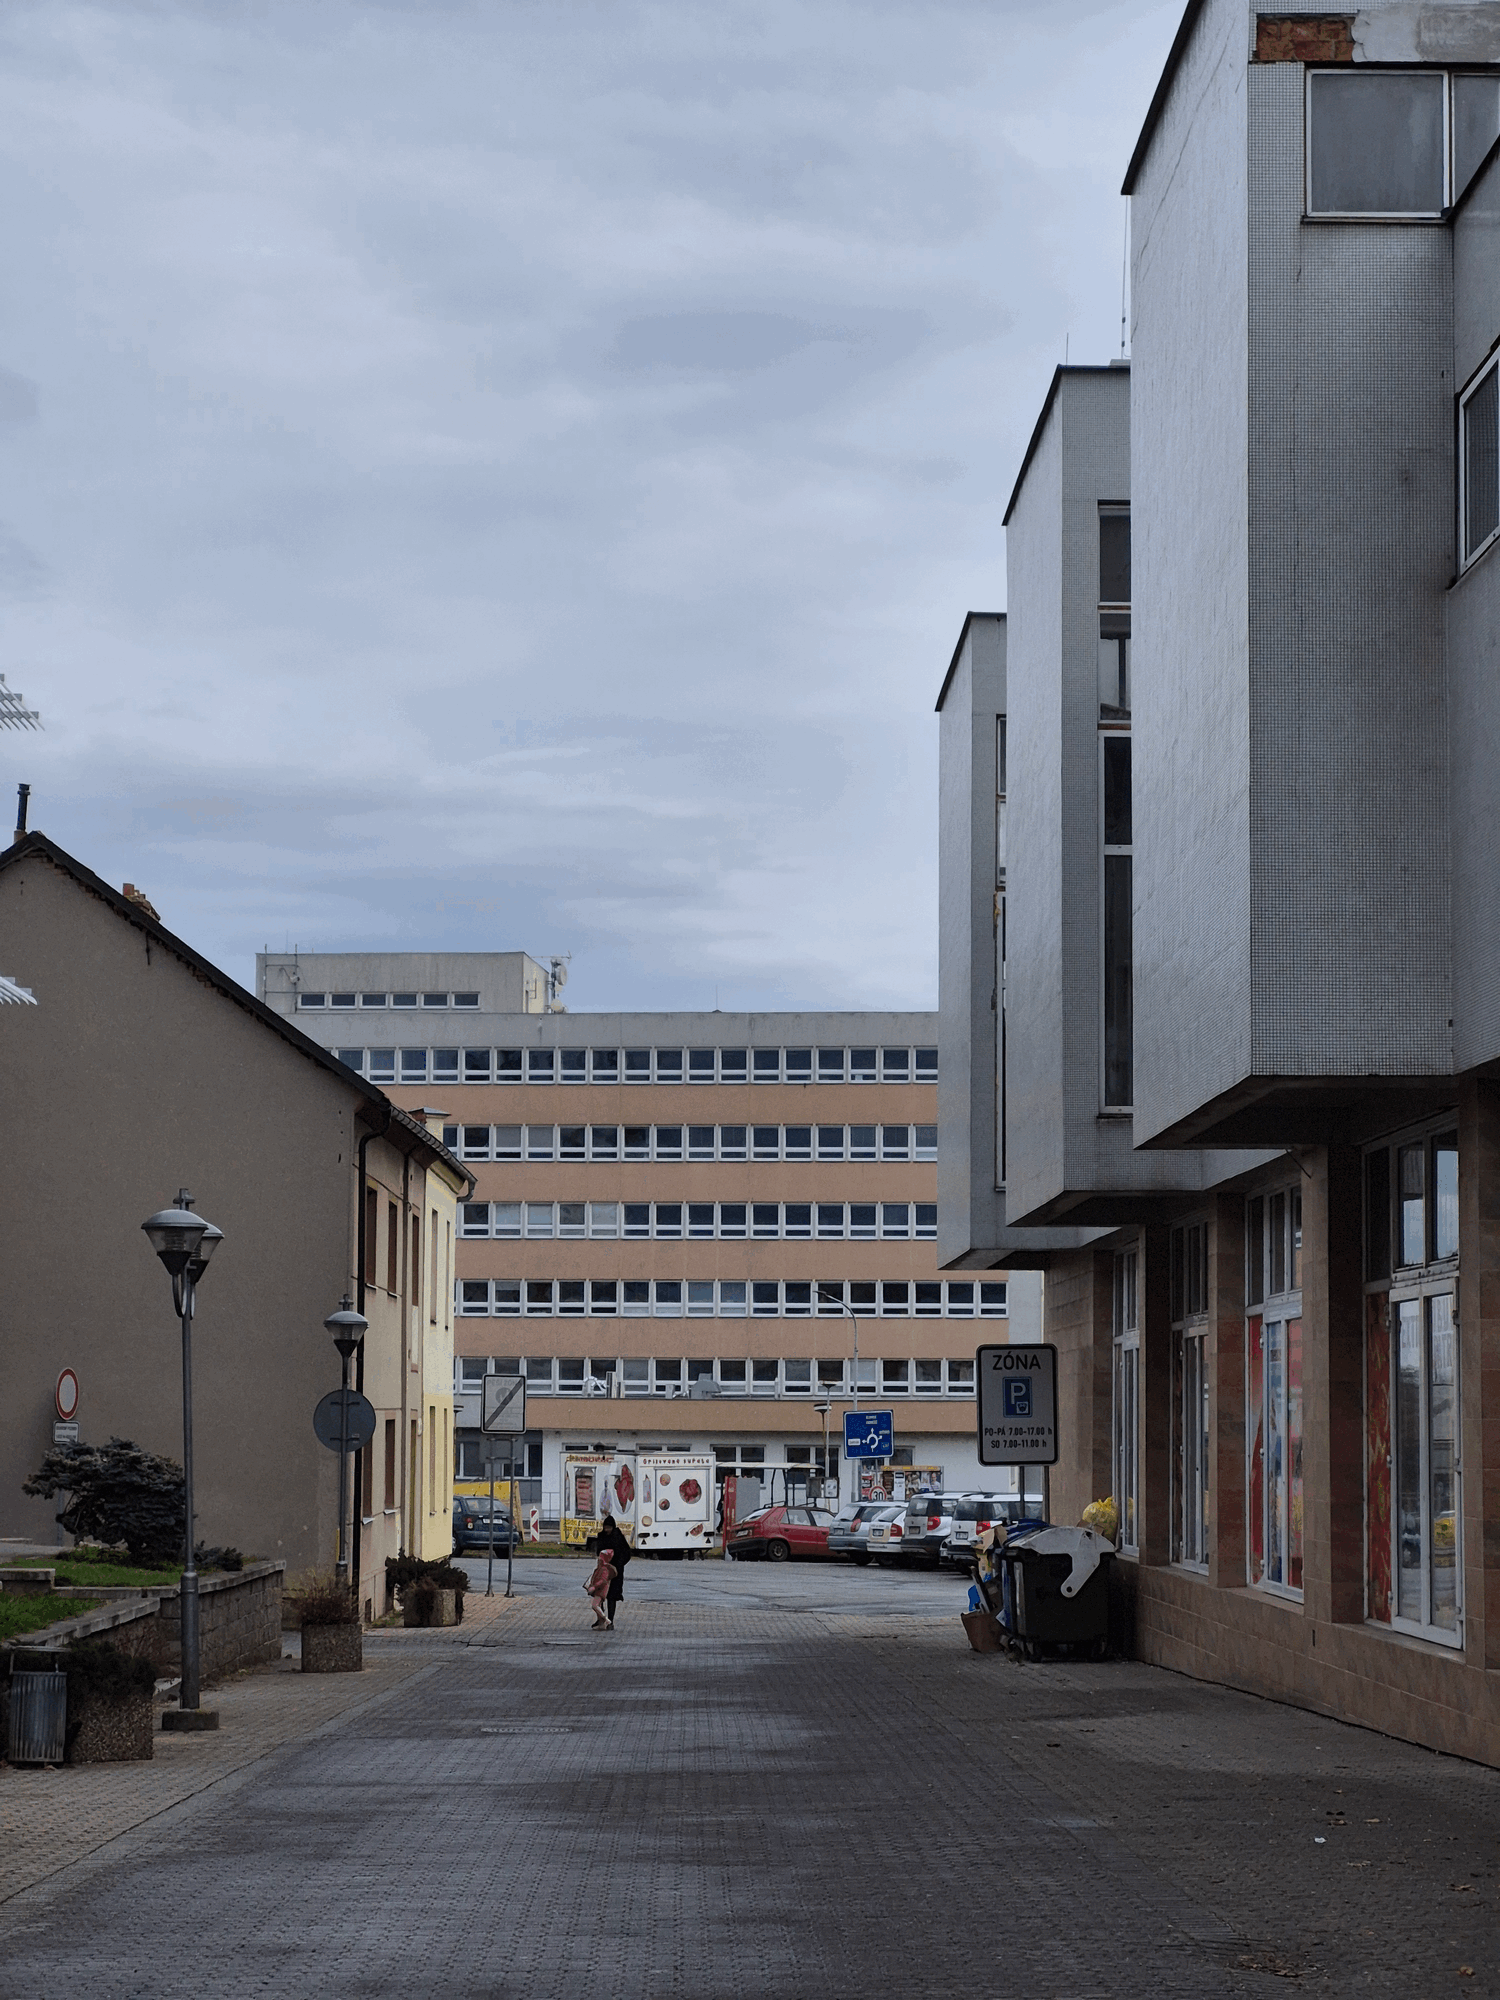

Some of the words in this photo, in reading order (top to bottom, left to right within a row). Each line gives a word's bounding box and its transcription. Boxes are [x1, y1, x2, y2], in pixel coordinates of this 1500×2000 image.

[992, 1351, 1041, 1370] ZÓNA
[1010, 1382, 1026, 1405] P
[984, 1426, 1006, 1436] PO-PÁ
[1009, 1427, 1045, 1436] 7.00-17.00
[1048, 1427, 1053, 1435] h
[991, 1440, 1000, 1449] SO
[1003, 1440, 1039, 1448] 7.00-11.00
[1042, 1439, 1047, 1448] h
[873, 1491, 884, 1500] 30
